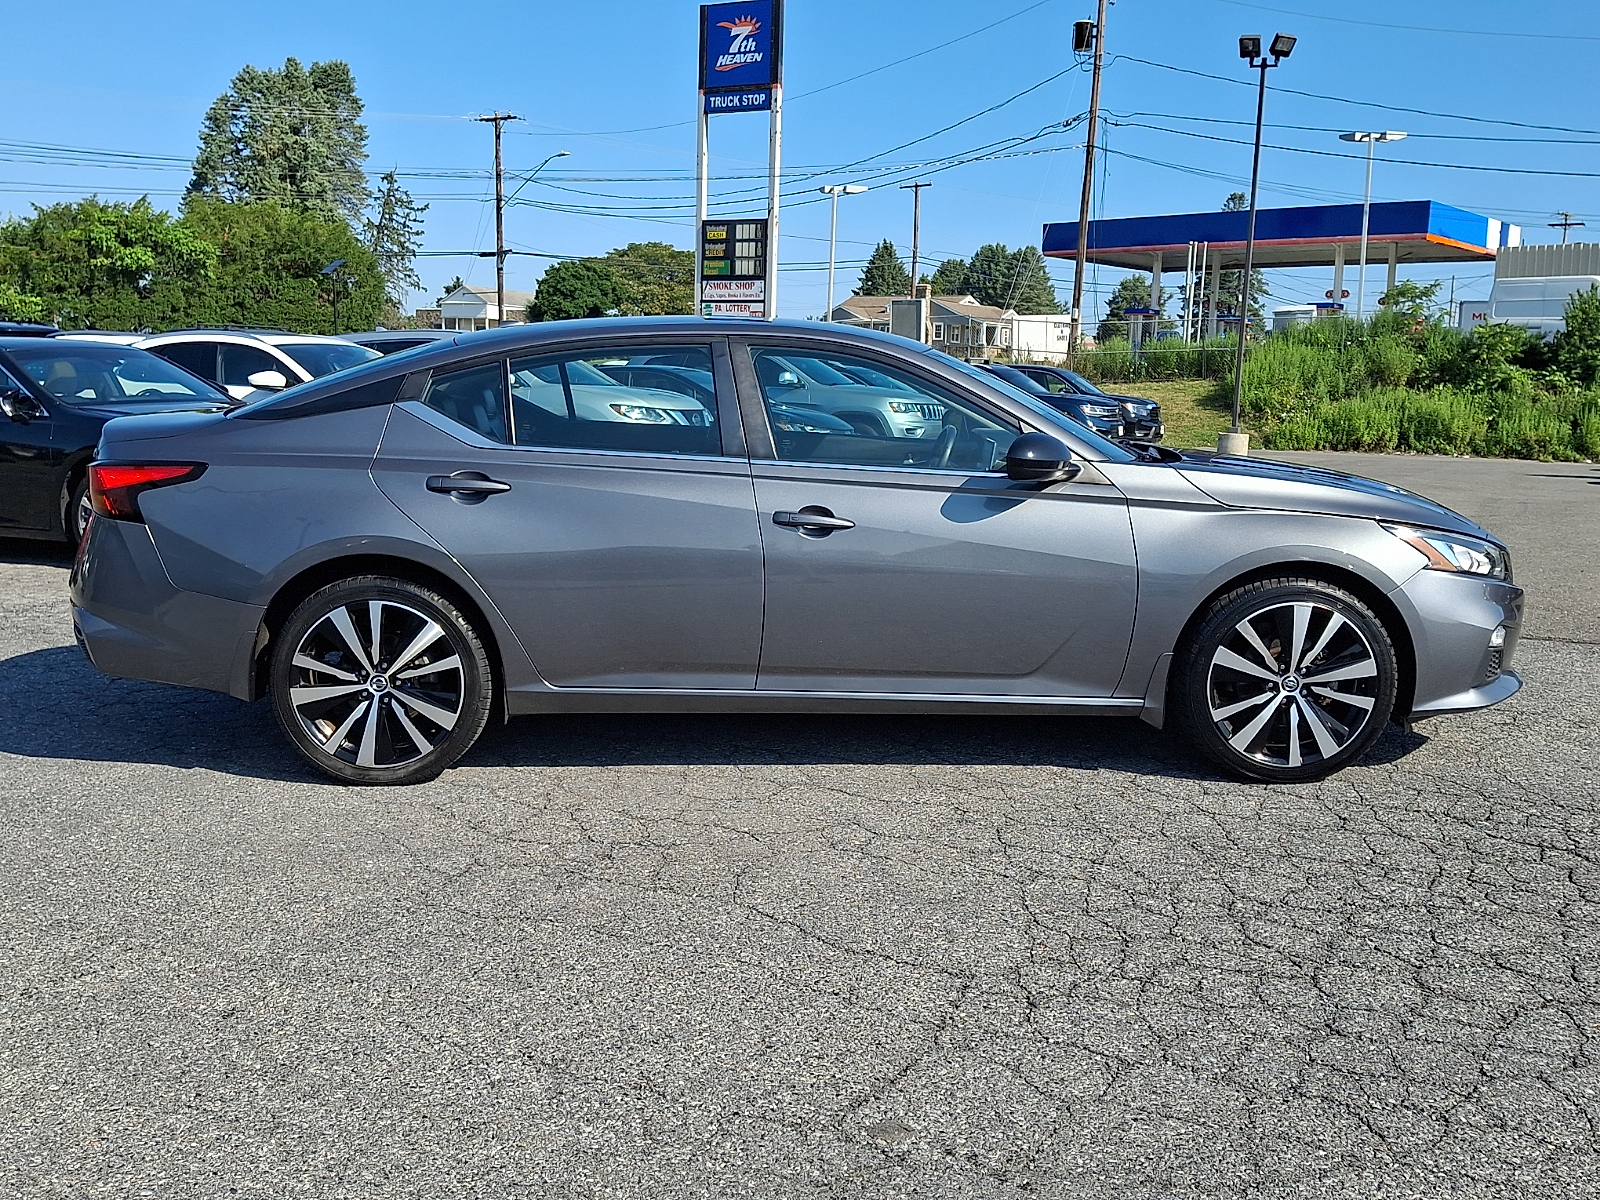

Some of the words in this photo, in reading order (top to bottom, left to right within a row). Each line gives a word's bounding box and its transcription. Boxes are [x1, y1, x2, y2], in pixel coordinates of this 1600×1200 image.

[729, 26, 756, 53] 7th
[716, 52, 764, 67] HEAVEN
[710, 95, 740, 108] TRUCK
[742, 93, 766, 106] STOP
[708, 281, 733, 291] SMOKE
[735, 281, 755, 291] SHOP
[715, 304, 722, 312] PA
[725, 304, 751, 312] LOTTERY
